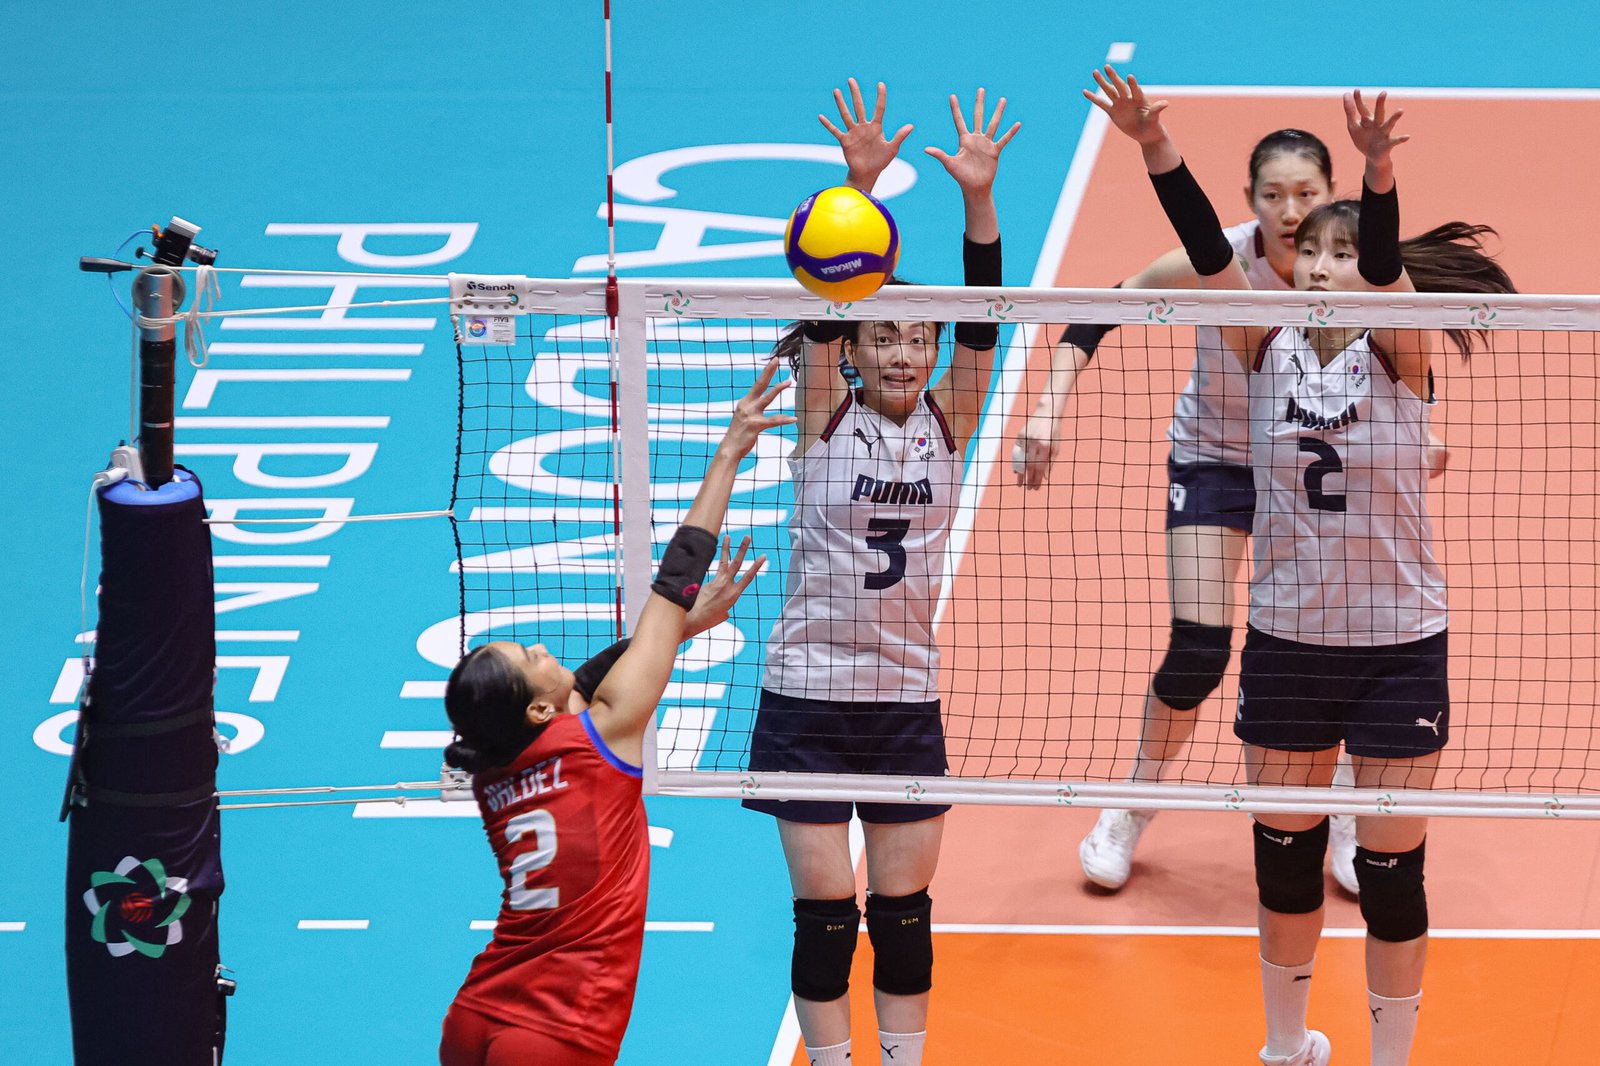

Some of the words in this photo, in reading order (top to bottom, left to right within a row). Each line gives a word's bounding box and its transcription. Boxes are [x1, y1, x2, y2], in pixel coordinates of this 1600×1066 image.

[477, 282, 515, 292] Senoh
[919, 451, 936, 462] KOR
[1299, 436, 1347, 512] 2
[850, 473, 934, 505] PUMA
[863, 517, 912, 590] 3
[504, 808, 560, 911] 2
